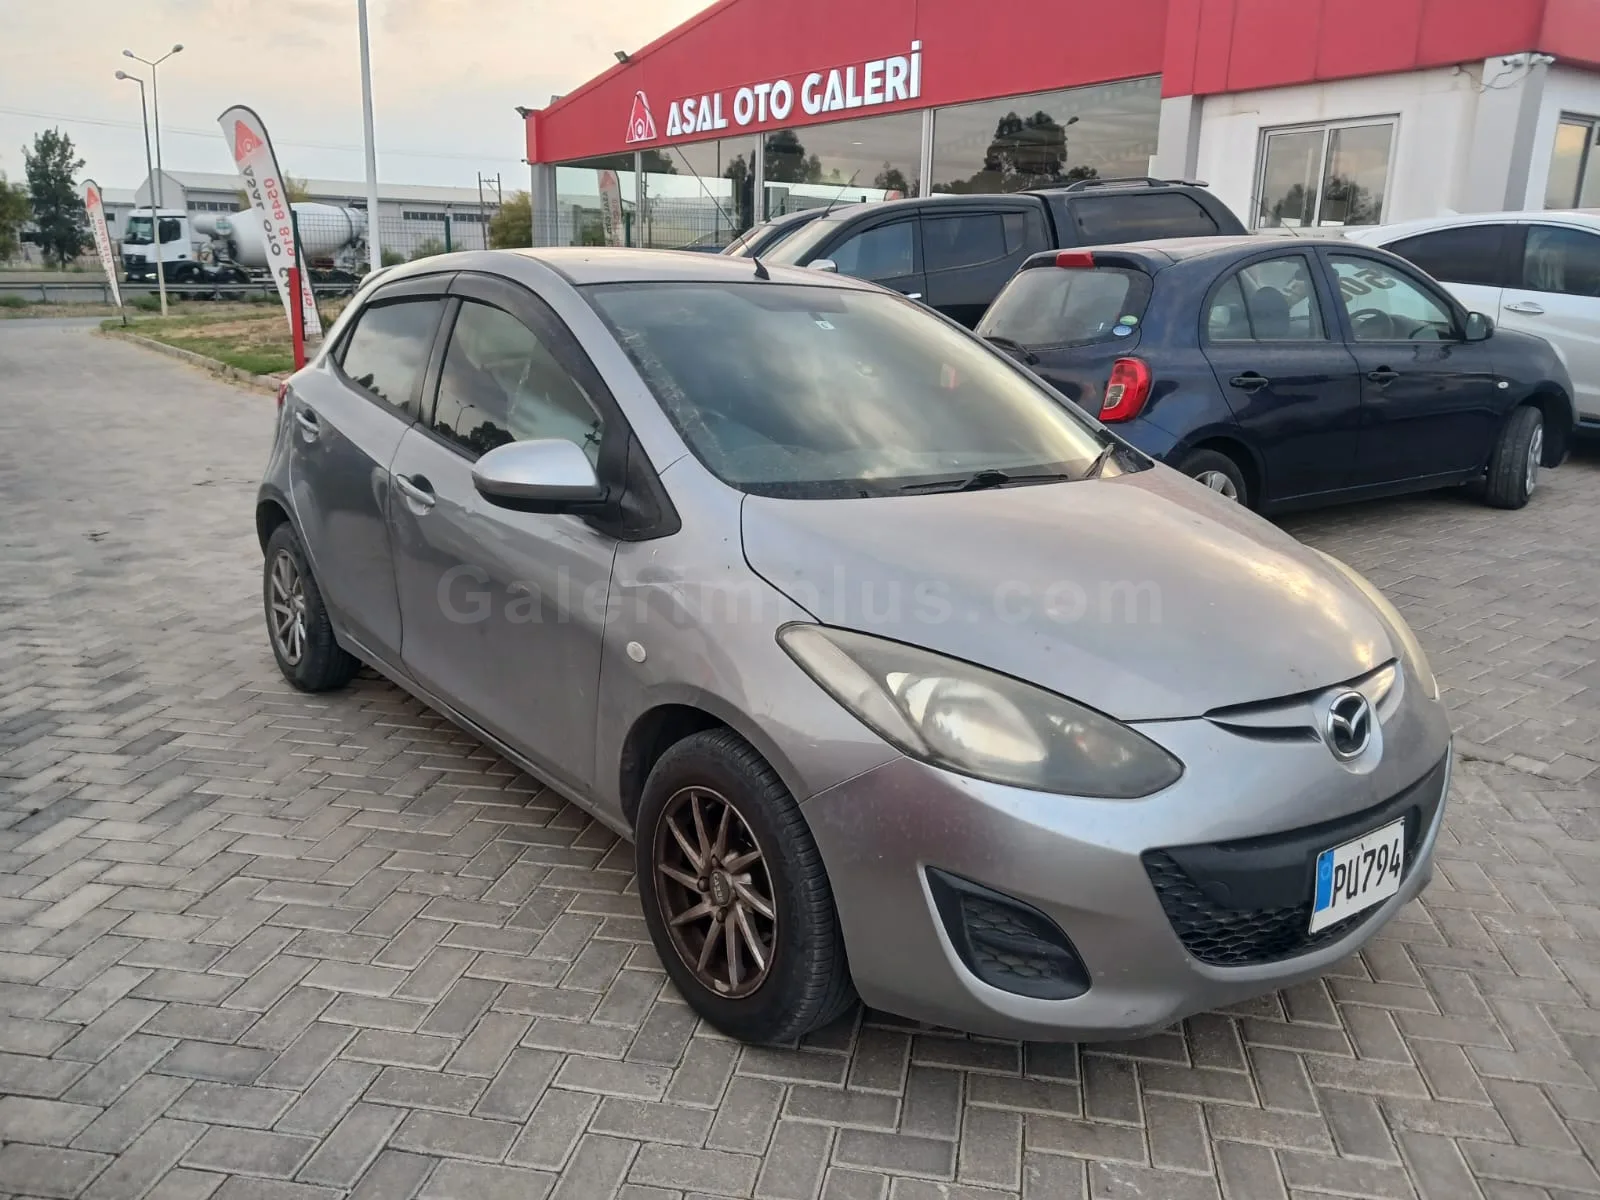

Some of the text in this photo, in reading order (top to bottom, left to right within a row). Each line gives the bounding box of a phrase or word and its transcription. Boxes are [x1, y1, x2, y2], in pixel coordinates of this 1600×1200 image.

[666, 39, 922, 137] ASAL OTO GALERİ
